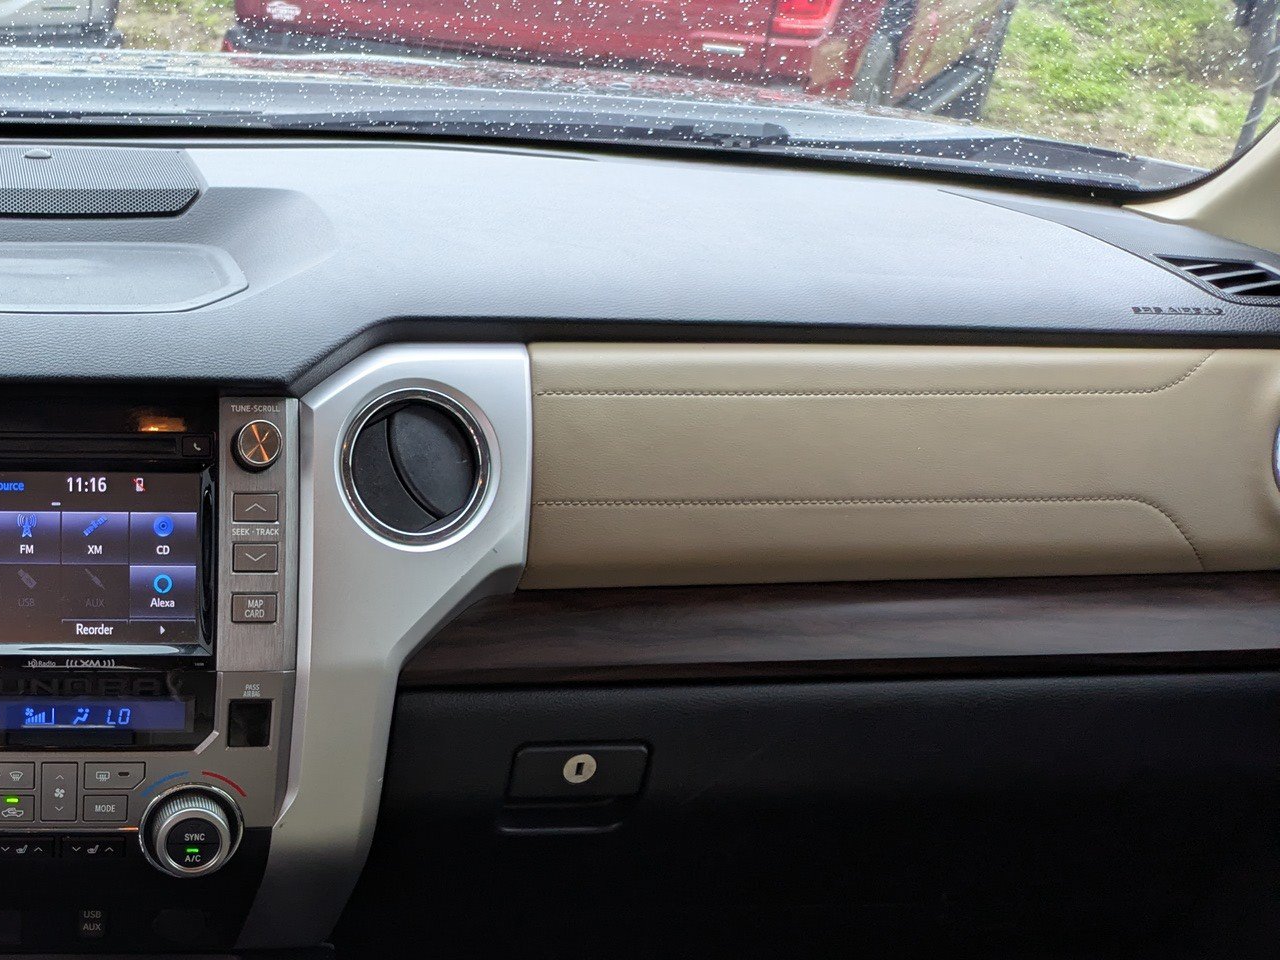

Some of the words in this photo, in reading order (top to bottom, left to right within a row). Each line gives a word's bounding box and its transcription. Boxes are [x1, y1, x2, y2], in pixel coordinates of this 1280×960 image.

[66, 477, 107, 493] 11:16
[20, 545, 34, 554] FM
[87, 545, 103, 555] XM
[156, 545, 170, 555] CD
[85, 598, 105, 607] AUX
[150, 598, 175, 608] Alexa
[248, 600, 264, 608] MAP
[245, 610, 265, 618] CARD
[76, 624, 113, 635] Reorder
[106, 708, 131, 725] LO
[95, 805, 116, 813] MODE
[184, 833, 205, 842] SYNC
[83, 911, 101, 919] USB
[83, 923, 101, 931] AUX
